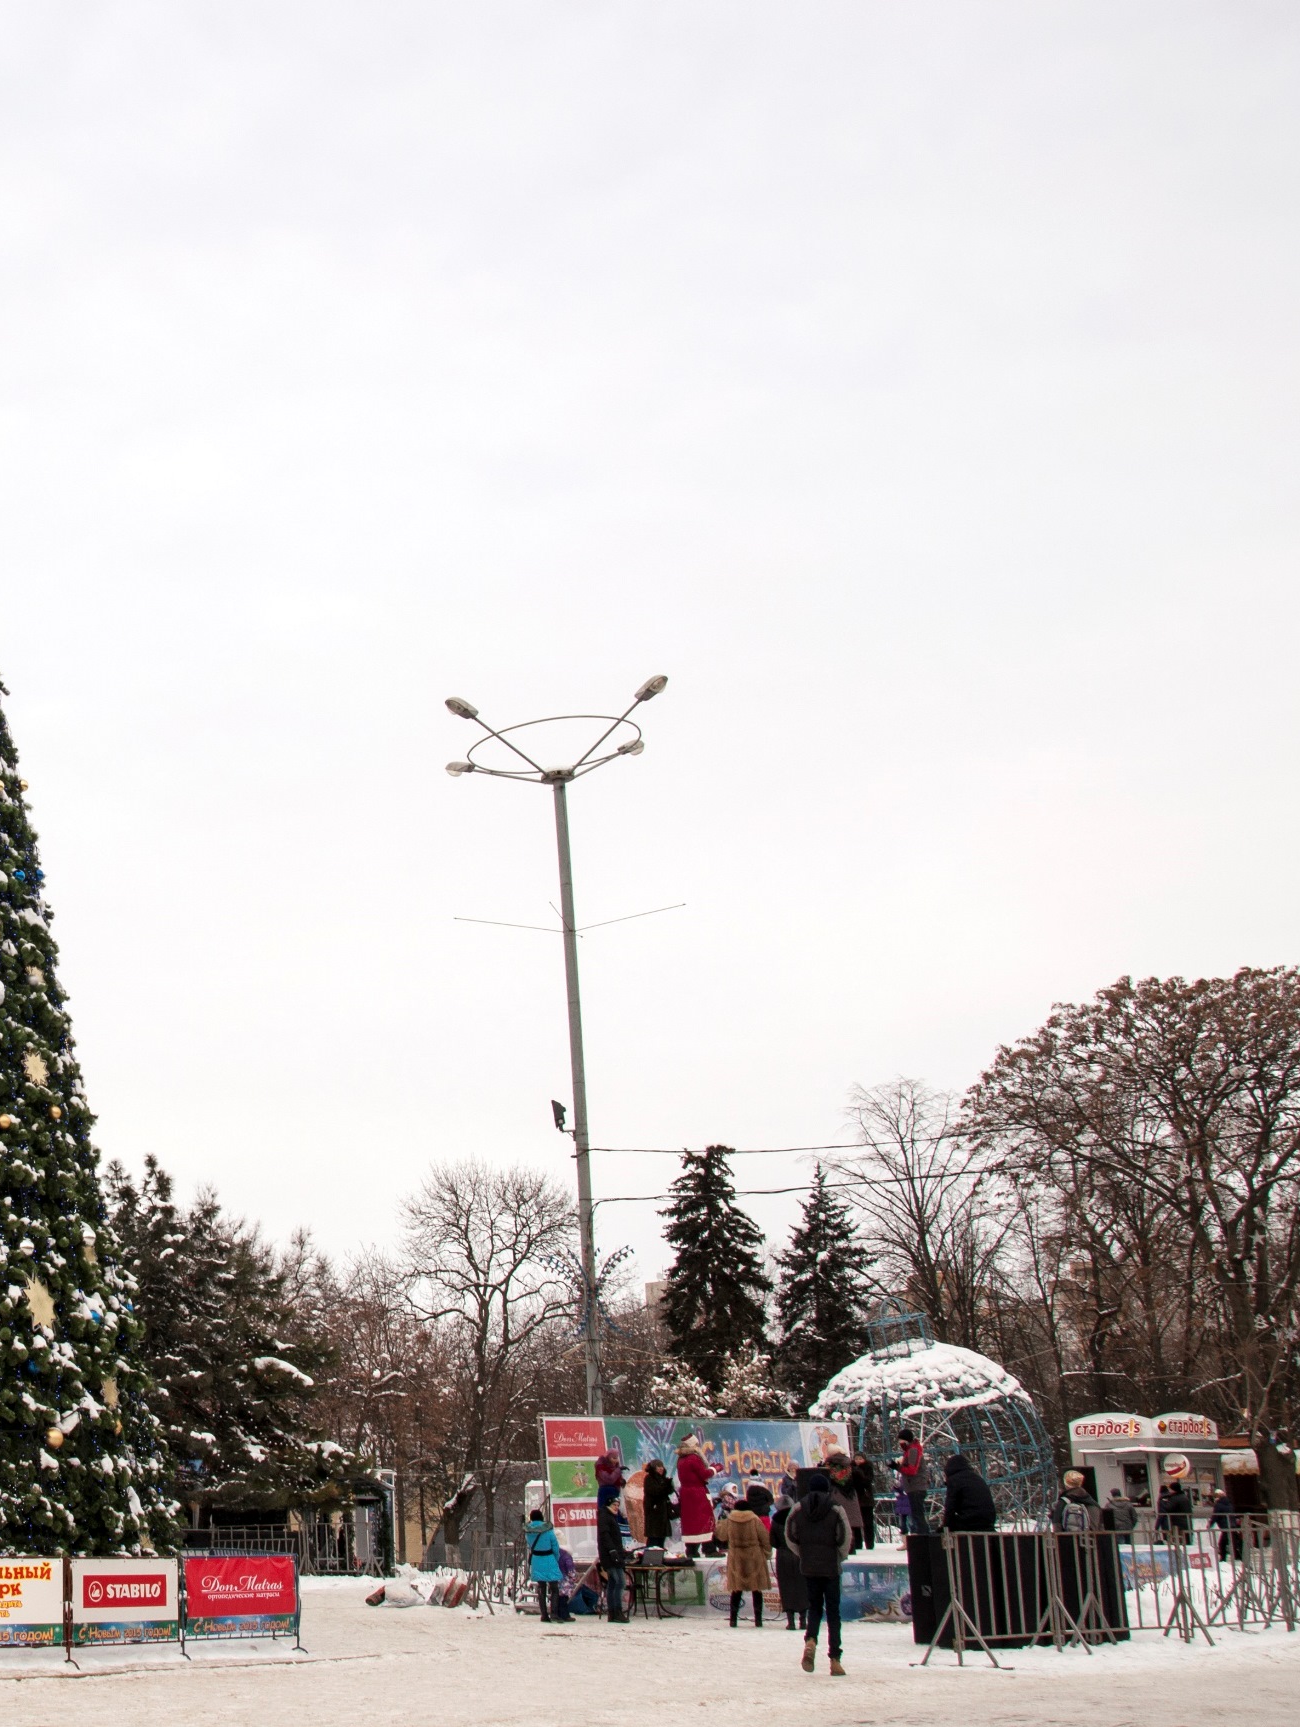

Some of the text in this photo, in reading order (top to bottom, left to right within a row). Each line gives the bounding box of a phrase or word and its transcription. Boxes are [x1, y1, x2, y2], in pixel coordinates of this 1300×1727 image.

[570, 1509, 598, 1520] STABI
[201, 1574, 284, 1592] Don Matras
[106, 1583, 161, 1599] STABILO
[239, 1621, 258, 1630] 2015
[124, 1628, 141, 1638] 2015
